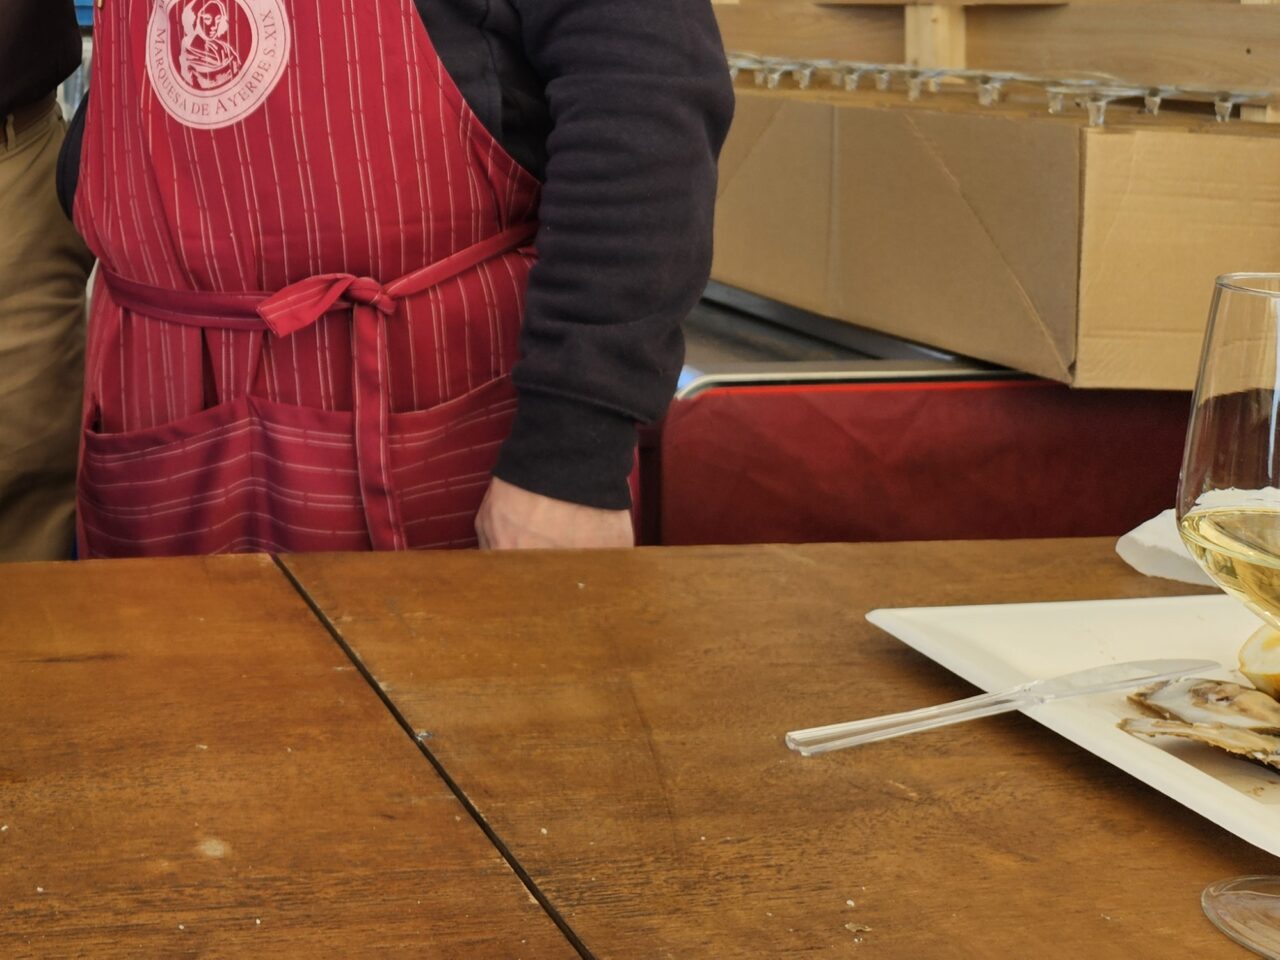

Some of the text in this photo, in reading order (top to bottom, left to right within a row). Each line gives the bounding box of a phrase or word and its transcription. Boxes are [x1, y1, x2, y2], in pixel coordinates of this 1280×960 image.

[154, 27, 187, 111] MARQUESA
[191, 101, 209, 116] DE
[215, 60, 271, 115] AYERBE
